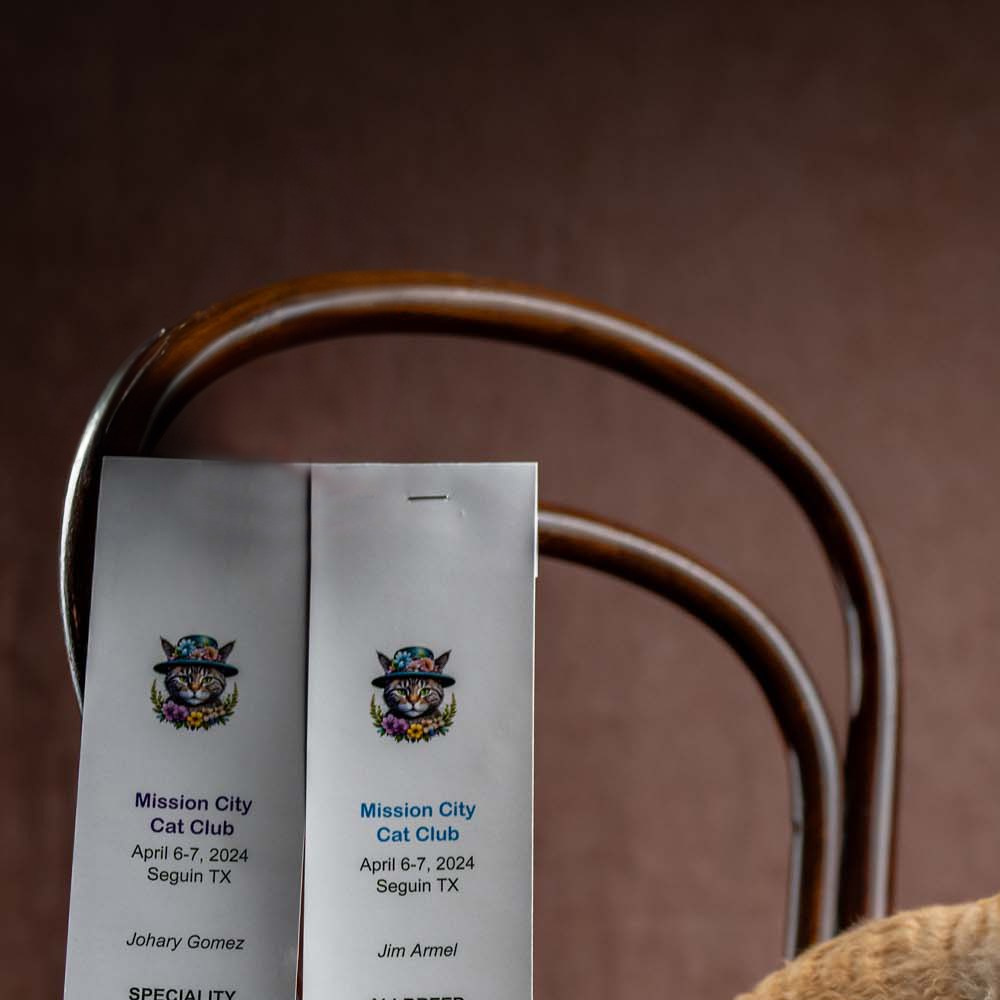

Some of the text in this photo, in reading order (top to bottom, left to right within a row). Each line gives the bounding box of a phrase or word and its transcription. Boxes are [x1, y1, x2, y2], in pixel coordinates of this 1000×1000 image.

[135, 792, 252, 815] Mission City
[360, 801, 477, 820] Mission City
[150, 817, 235, 836] Cat Club
[376, 826, 460, 842] Cat Club
[131, 844, 249, 863] April 6-7, 2024
[360, 856, 475, 875] April 6-7, 2024
[147, 867, 232, 885] Seguin TX
[376, 878, 460, 896] Seguin TX
[126, 932, 245, 951] Johary Gomez
[377, 942, 458, 958] Jim Armel
